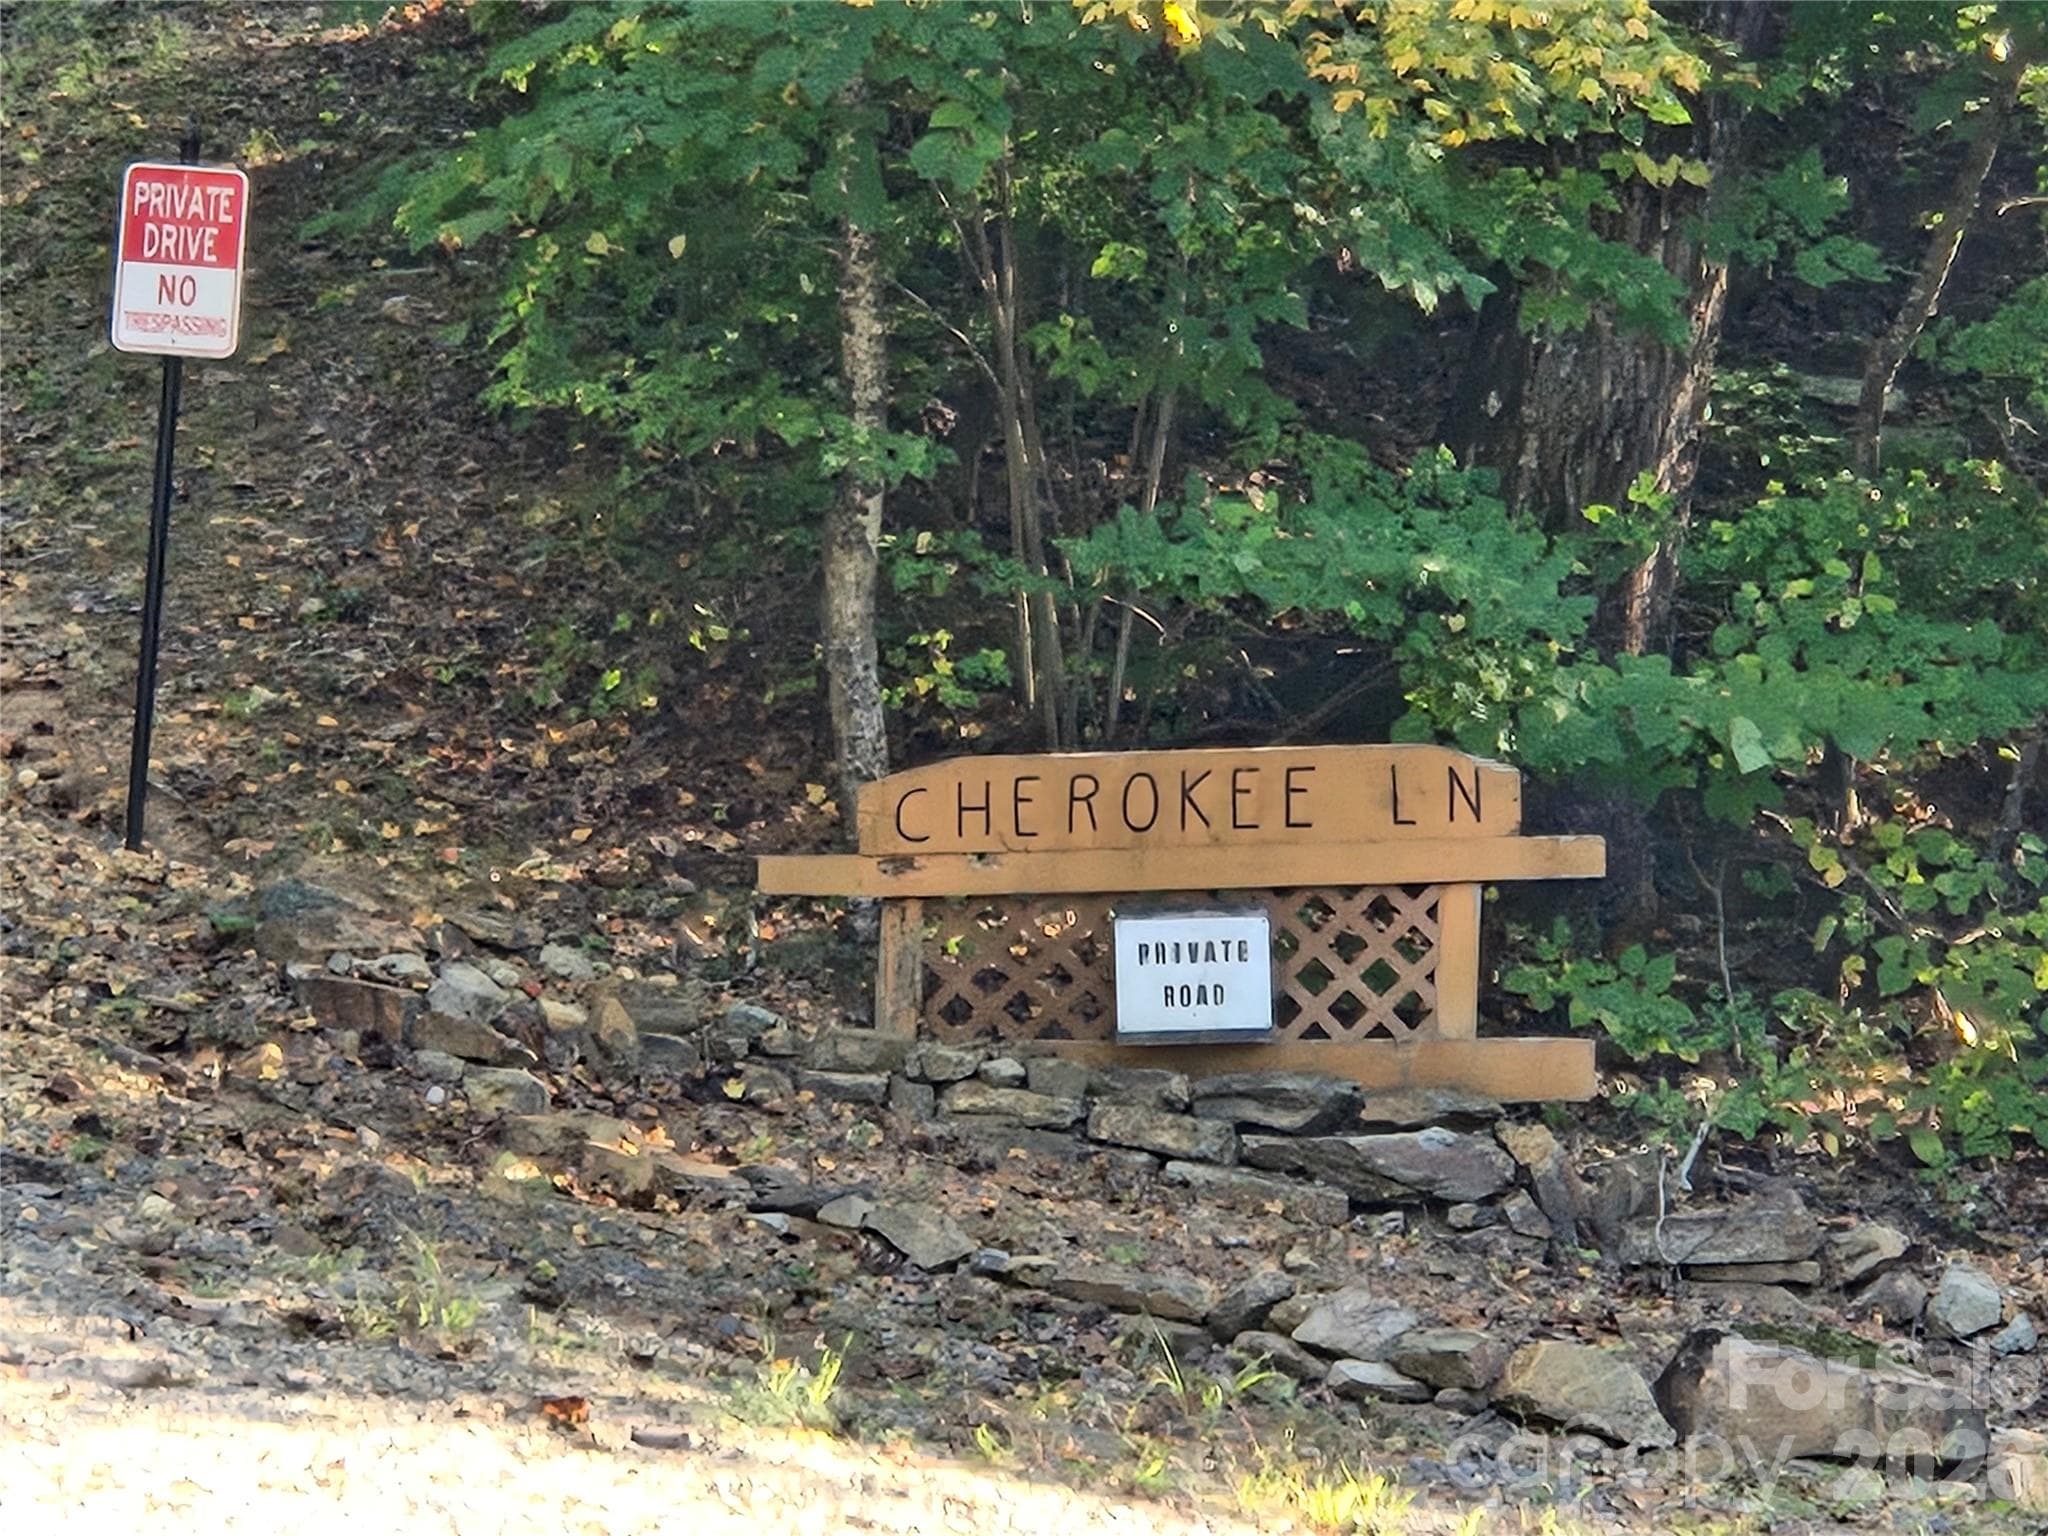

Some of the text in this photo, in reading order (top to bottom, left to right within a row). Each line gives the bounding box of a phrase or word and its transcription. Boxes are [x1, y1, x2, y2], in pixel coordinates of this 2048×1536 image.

[134, 181, 235, 224] PRIVATE
[143, 222, 220, 262] DRIVE
[158, 274, 197, 306] NO
[896, 763, 1483, 843] CHEROKEE LN
[1138, 939, 1249, 966] PRIVATE
[1164, 983, 1225, 1008] ROAD
